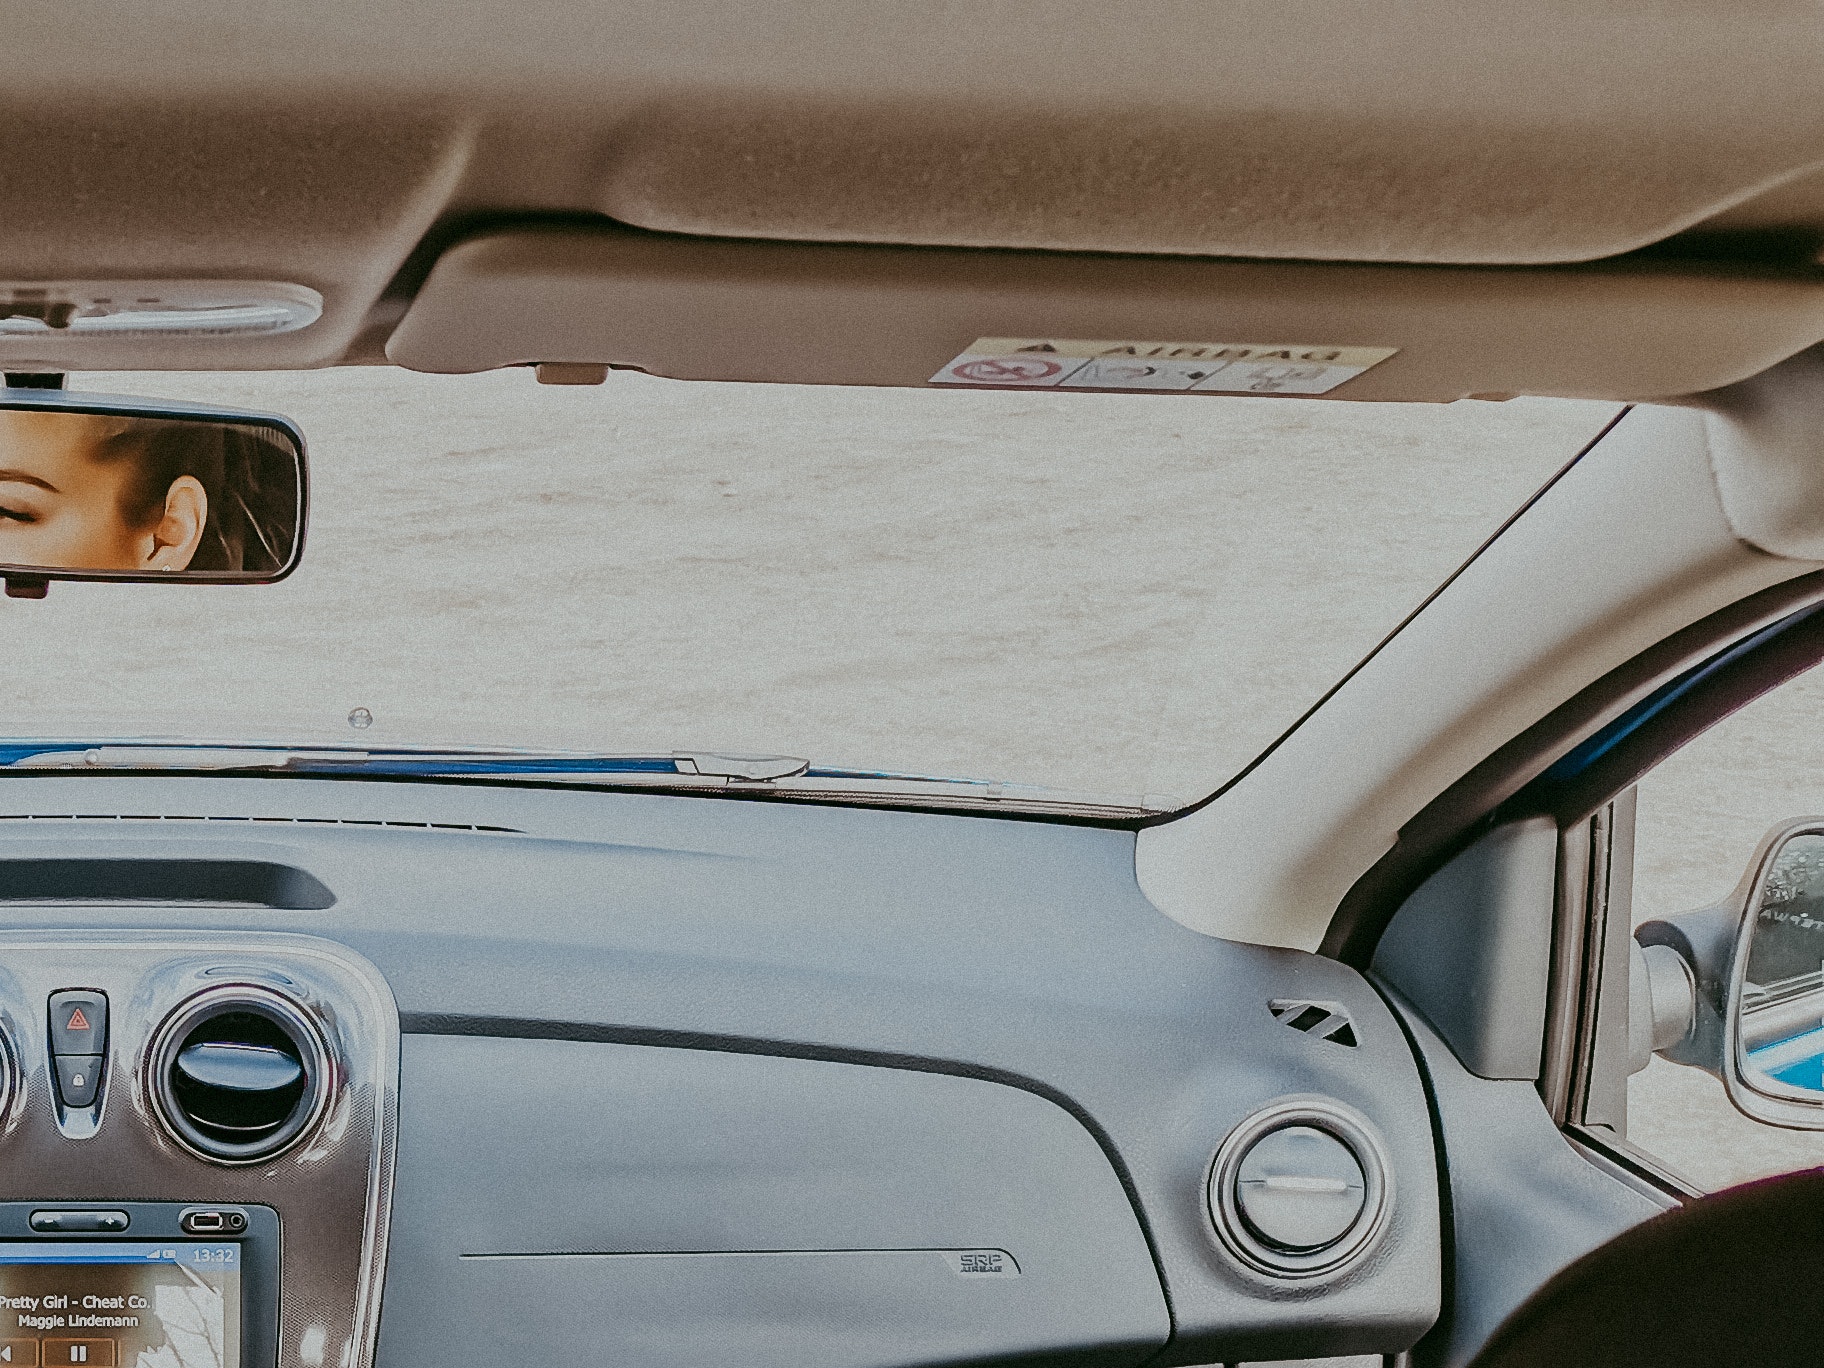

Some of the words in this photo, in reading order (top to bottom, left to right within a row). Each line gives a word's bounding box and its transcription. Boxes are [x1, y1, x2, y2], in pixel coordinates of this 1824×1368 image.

[193, 1248, 234, 1263] 13:32
[42, 1294, 68, 1309] Girl
[82, 1295, 125, 1309] Cheat
[18, 1314, 65, 1330] Maggie
[68, 1314, 139, 1327] Lindemann
